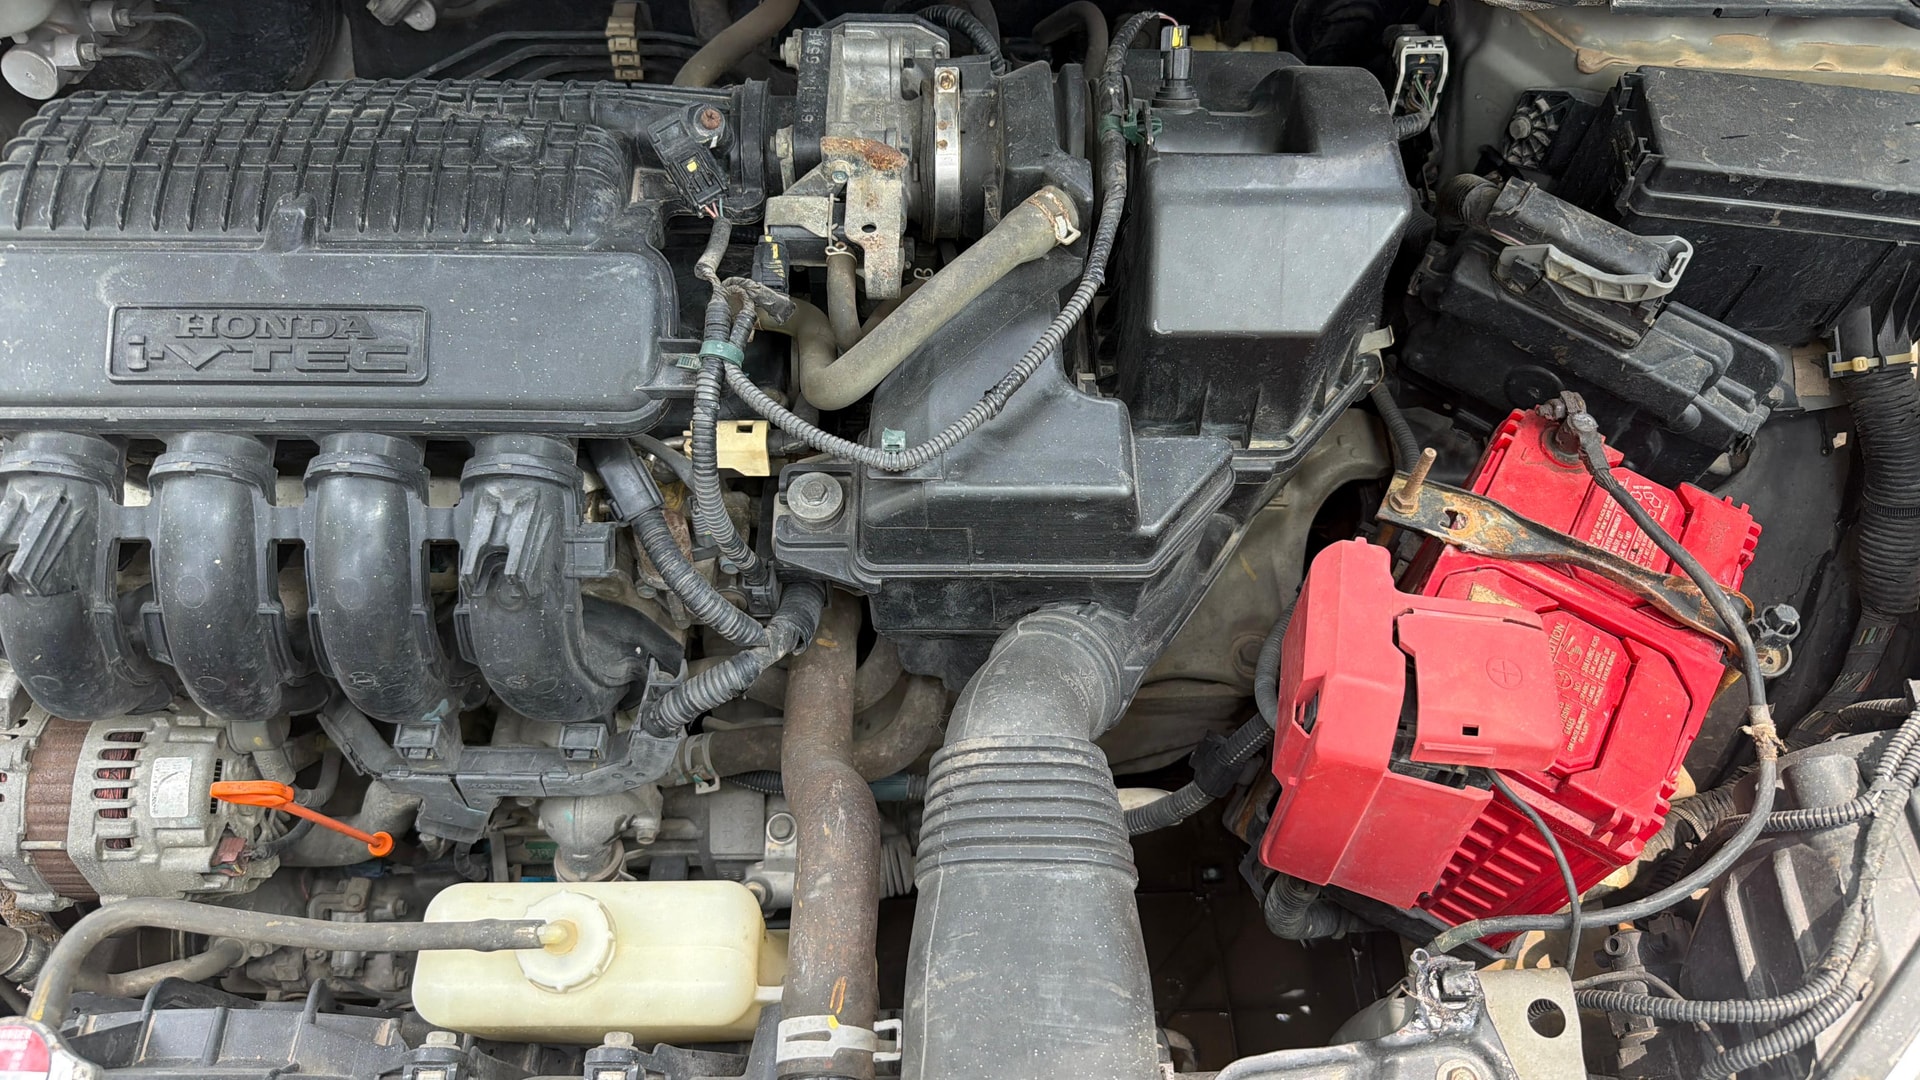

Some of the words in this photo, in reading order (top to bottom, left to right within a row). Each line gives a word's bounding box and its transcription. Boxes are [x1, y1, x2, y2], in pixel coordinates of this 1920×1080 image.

[175, 313, 378, 340] HONDA
[127, 335, 410, 373] i-VTEC
[1572, 681, 1581, 691] NO
[1563, 717, 1575, 734] GASES
